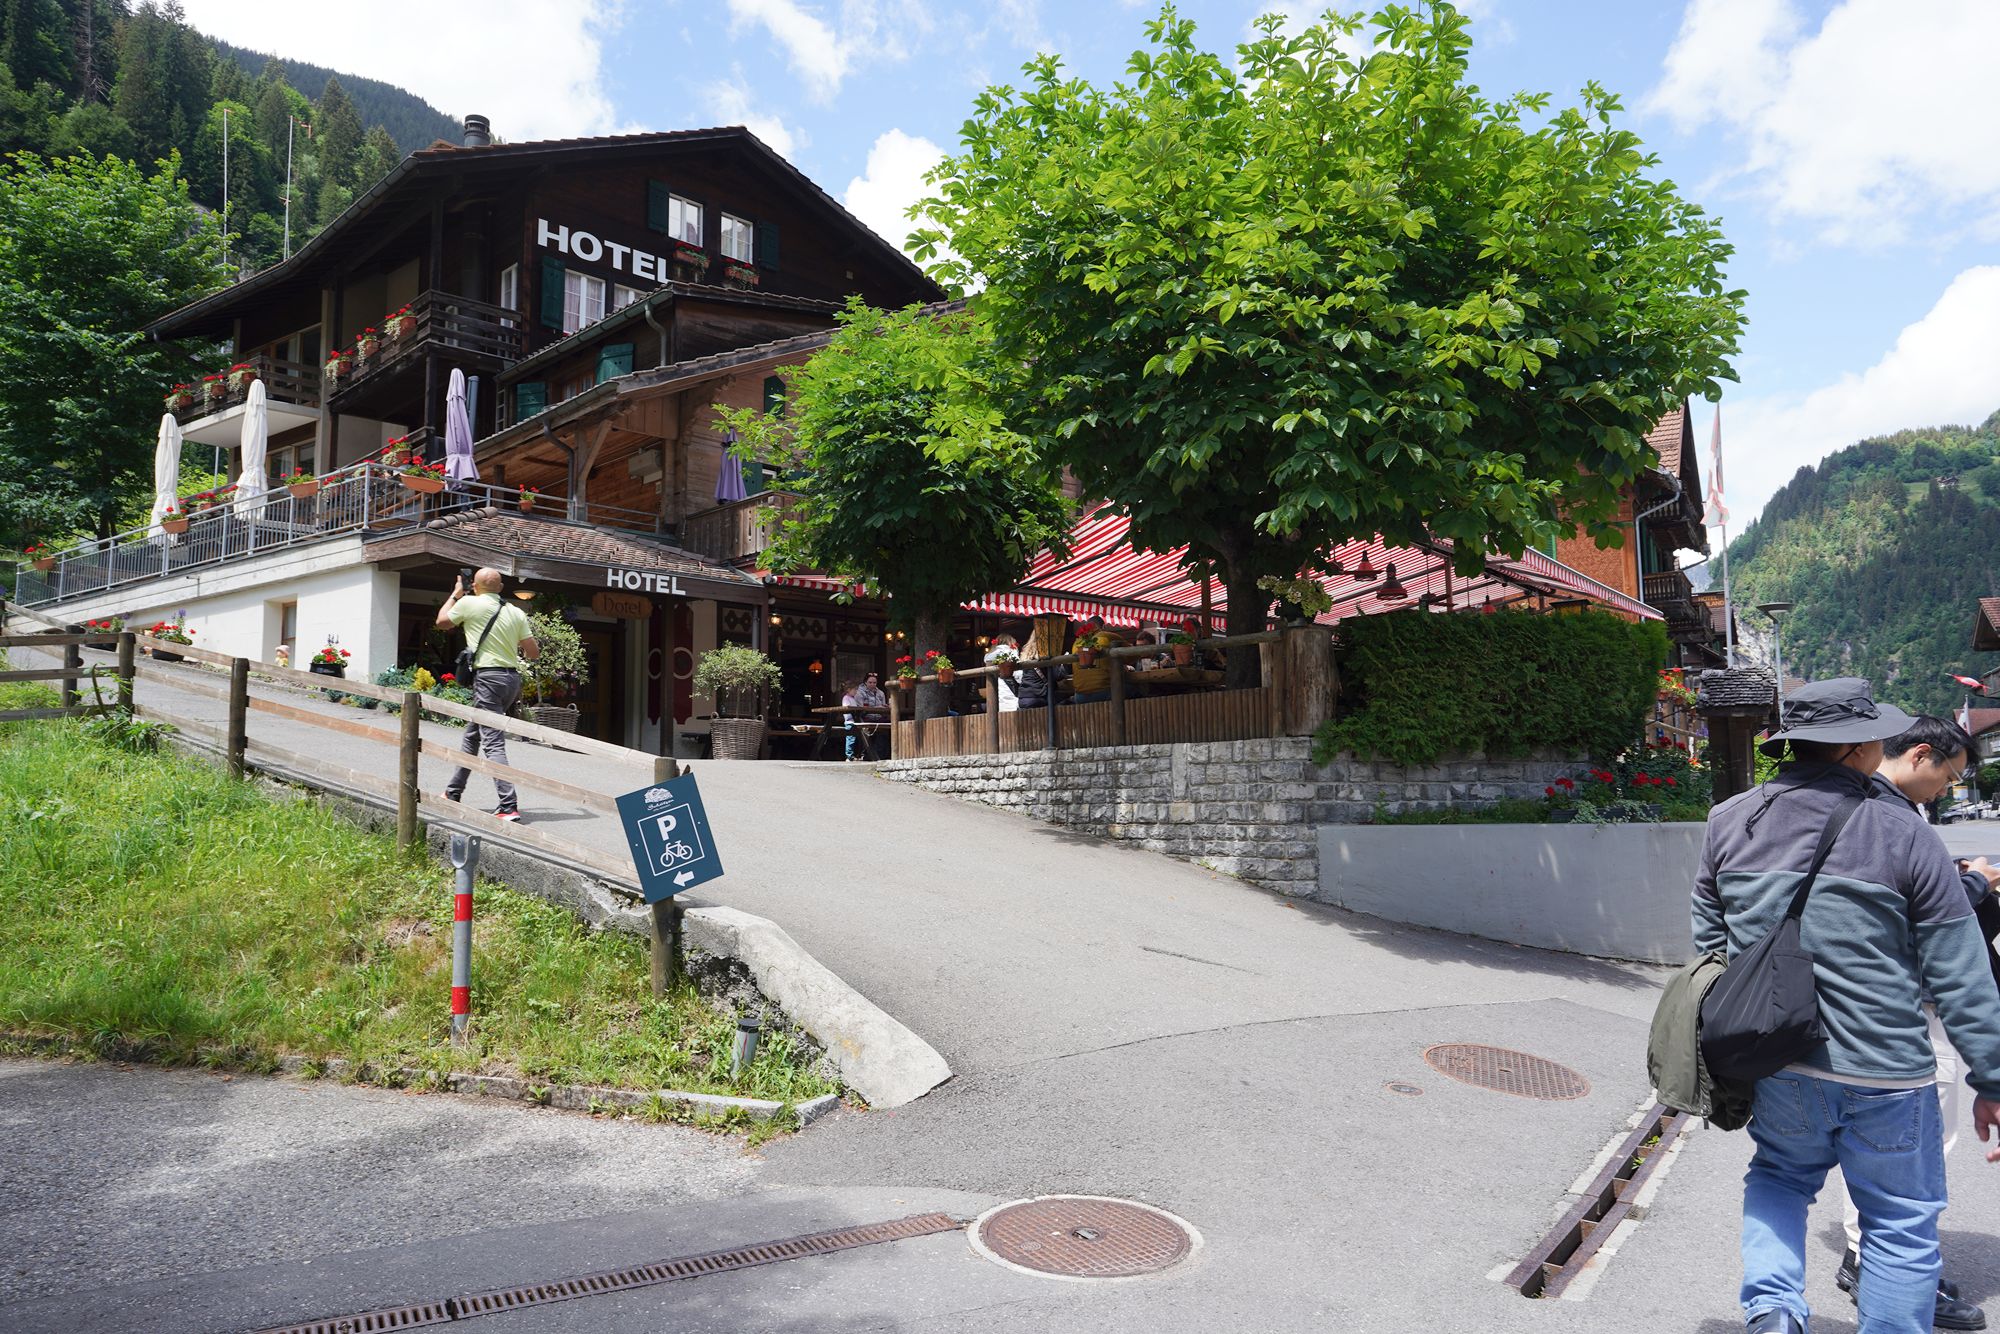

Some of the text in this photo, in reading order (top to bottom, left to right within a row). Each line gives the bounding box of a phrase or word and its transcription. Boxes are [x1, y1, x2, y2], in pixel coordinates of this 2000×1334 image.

[537, 218, 670, 284] HOTEL
[607, 568, 687, 596] HOTEL
[656, 814, 677, 841] P
